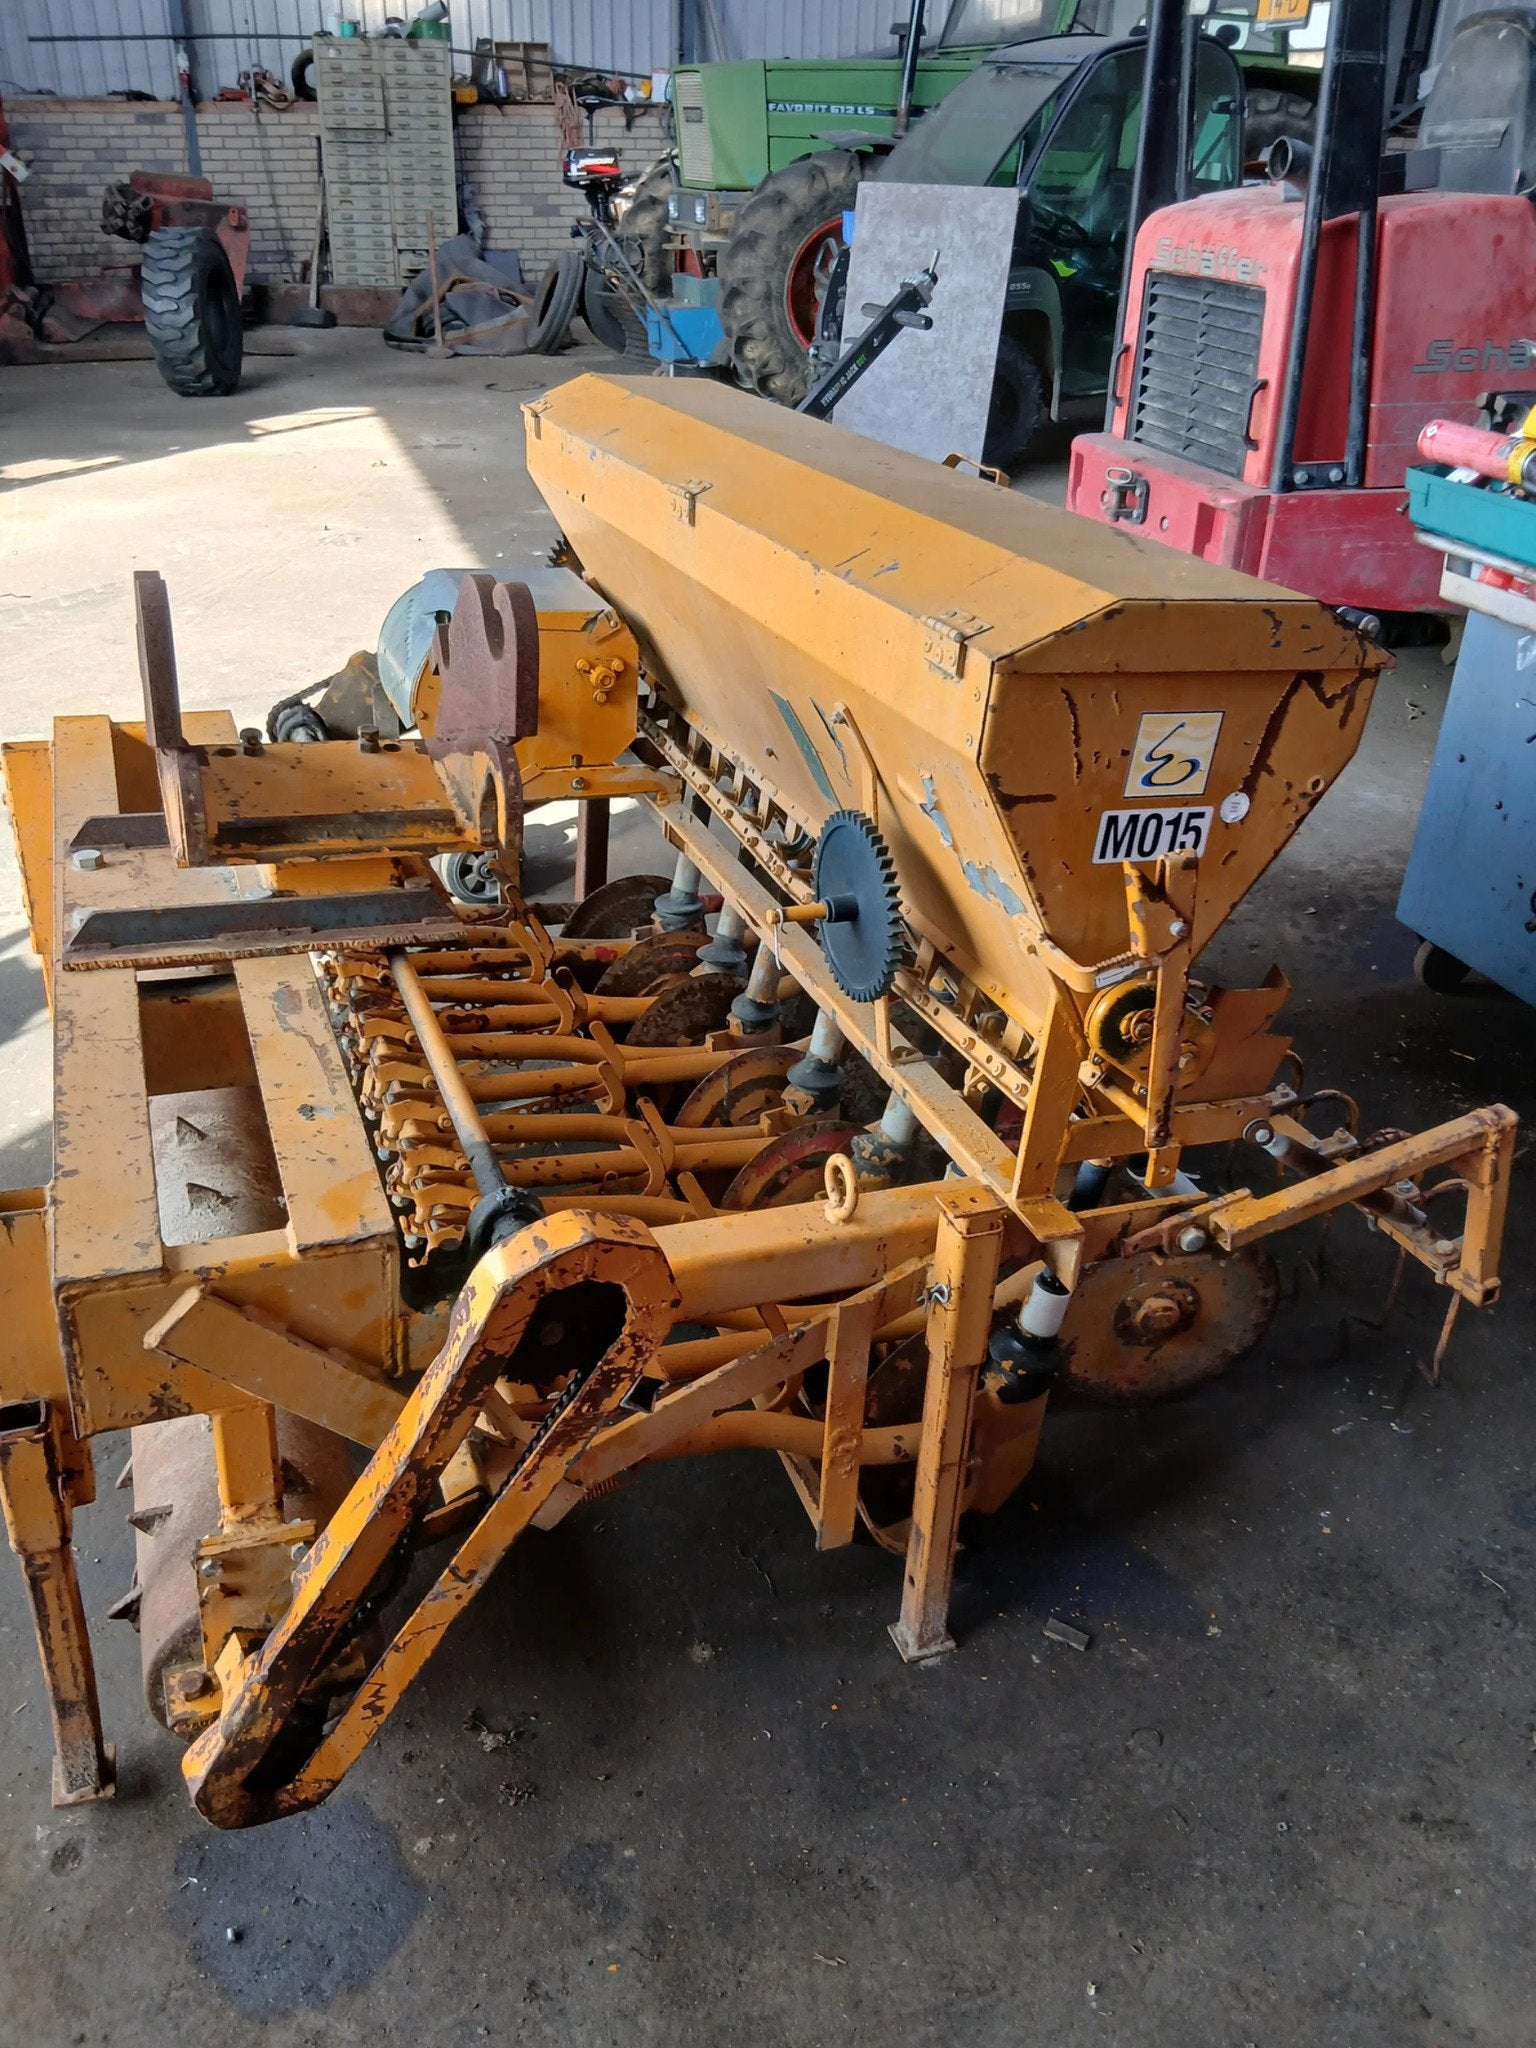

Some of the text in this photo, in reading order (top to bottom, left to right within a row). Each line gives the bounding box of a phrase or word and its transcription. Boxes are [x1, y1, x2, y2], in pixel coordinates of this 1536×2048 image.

[768, 103, 875, 115] FAVORIT 612 LS
[1149, 236, 1268, 284] Schäffer
[1099, 811, 1206, 859] M015
